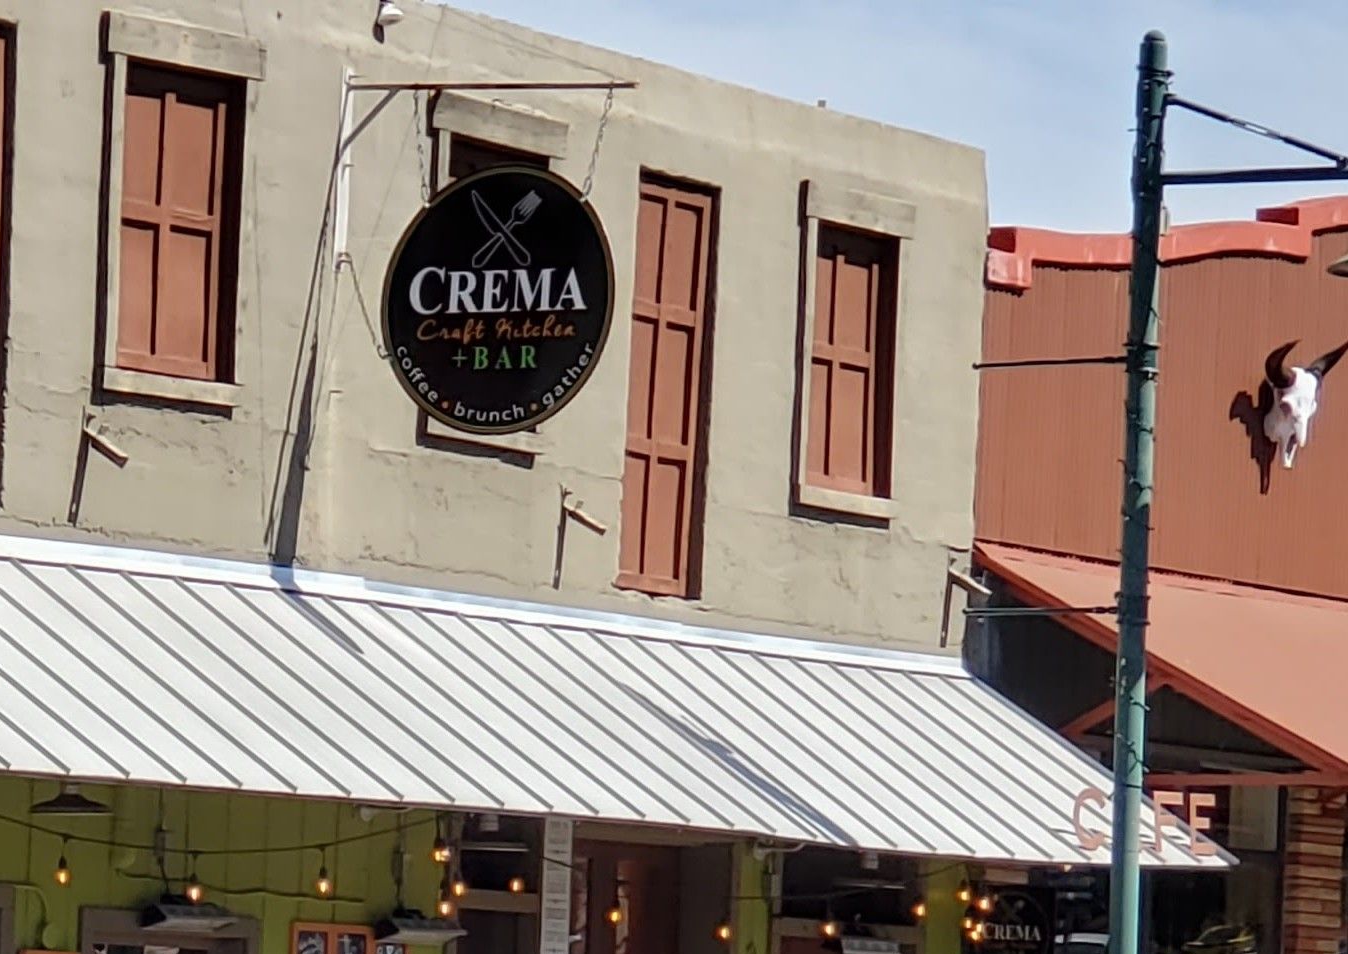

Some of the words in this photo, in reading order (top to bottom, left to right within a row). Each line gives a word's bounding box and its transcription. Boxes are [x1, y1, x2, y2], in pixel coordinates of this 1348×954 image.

[409, 266, 588, 315] CREMA
[416, 318, 485, 345] Craft
[495, 314, 576, 340] Kitchen
[396, 345, 439, 403] coffee
[454, 401, 525, 422] brunch
[542, 343, 594, 409] gather
[1073, 786, 1217, 857] CFE
